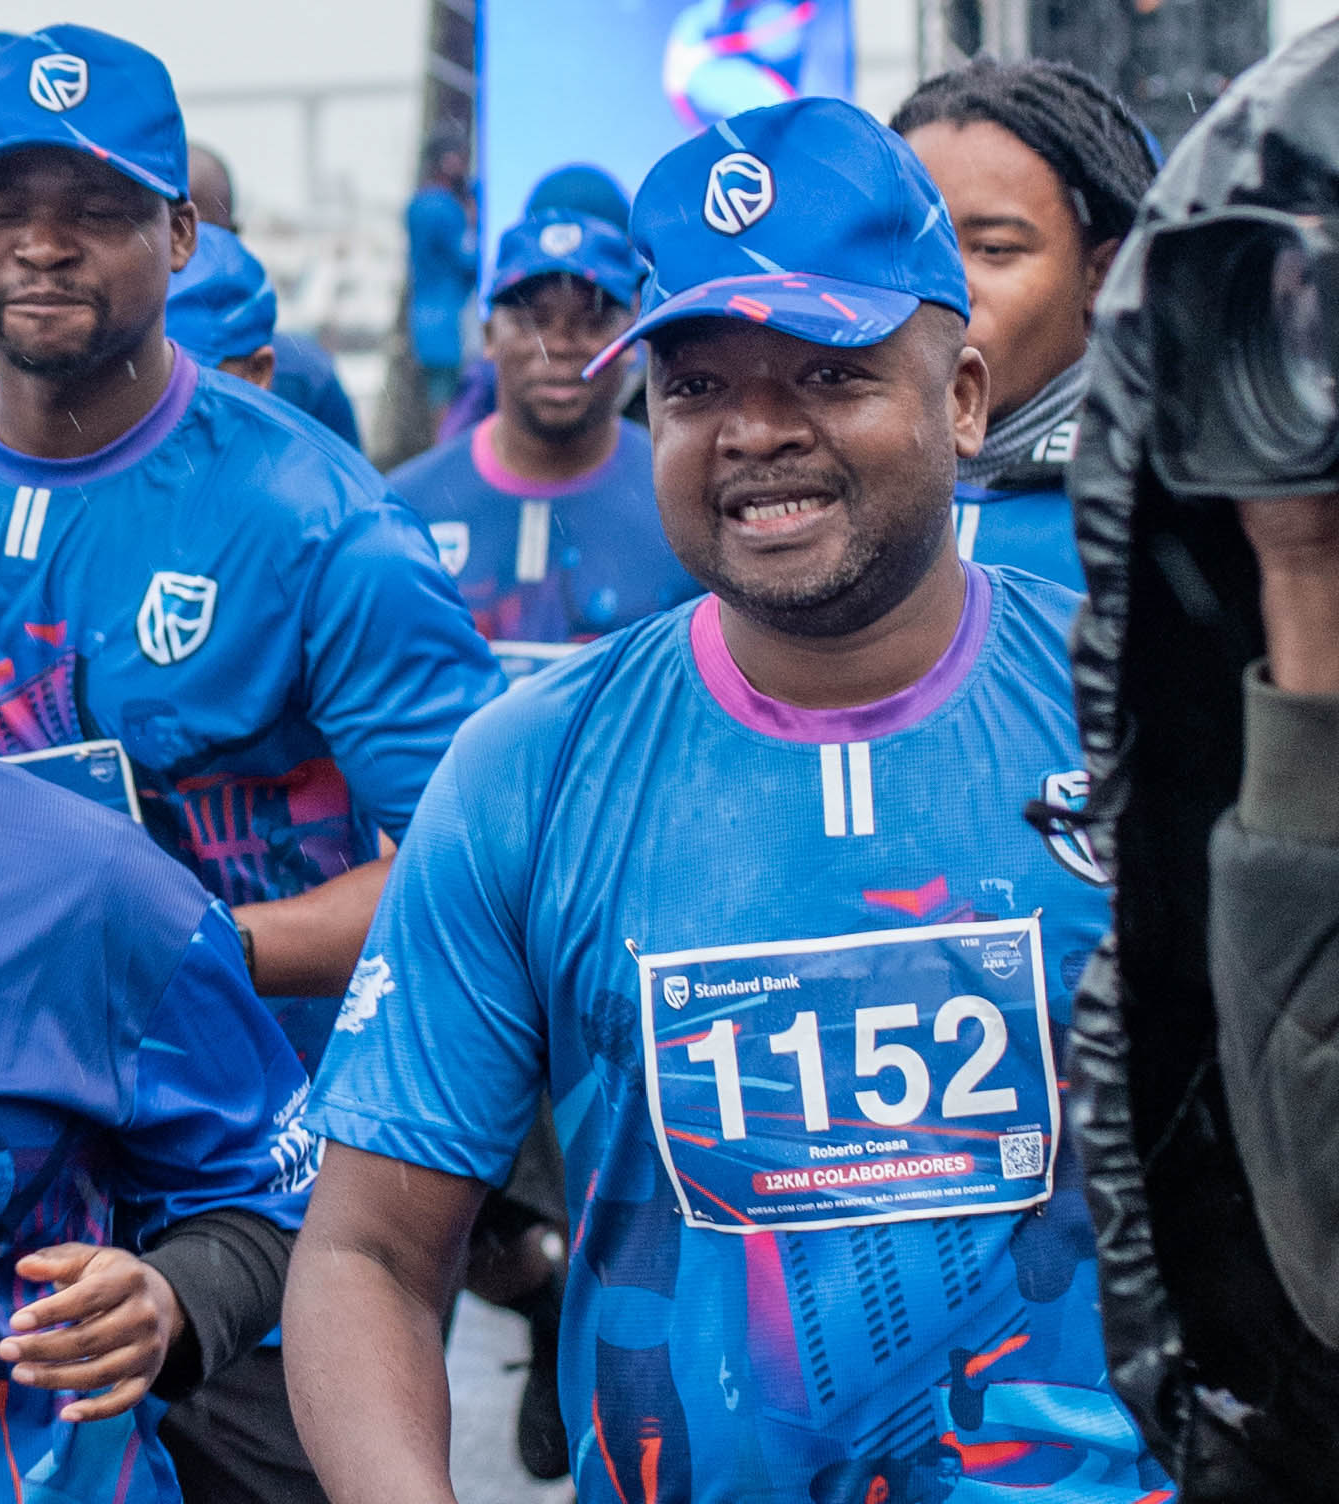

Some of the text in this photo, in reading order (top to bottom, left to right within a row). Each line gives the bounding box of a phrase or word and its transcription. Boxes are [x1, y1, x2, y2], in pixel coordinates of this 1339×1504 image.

[694, 973, 801, 998] Standard Bank
[687, 995, 1018, 1140] 1152
[809, 1139, 909, 1160] Roberto Cossa
[765, 1156, 967, 1191] 12KM COLABORADORES
[777, 1203, 796, 1214] COM
[943, 1186, 962, 1197] NEM
